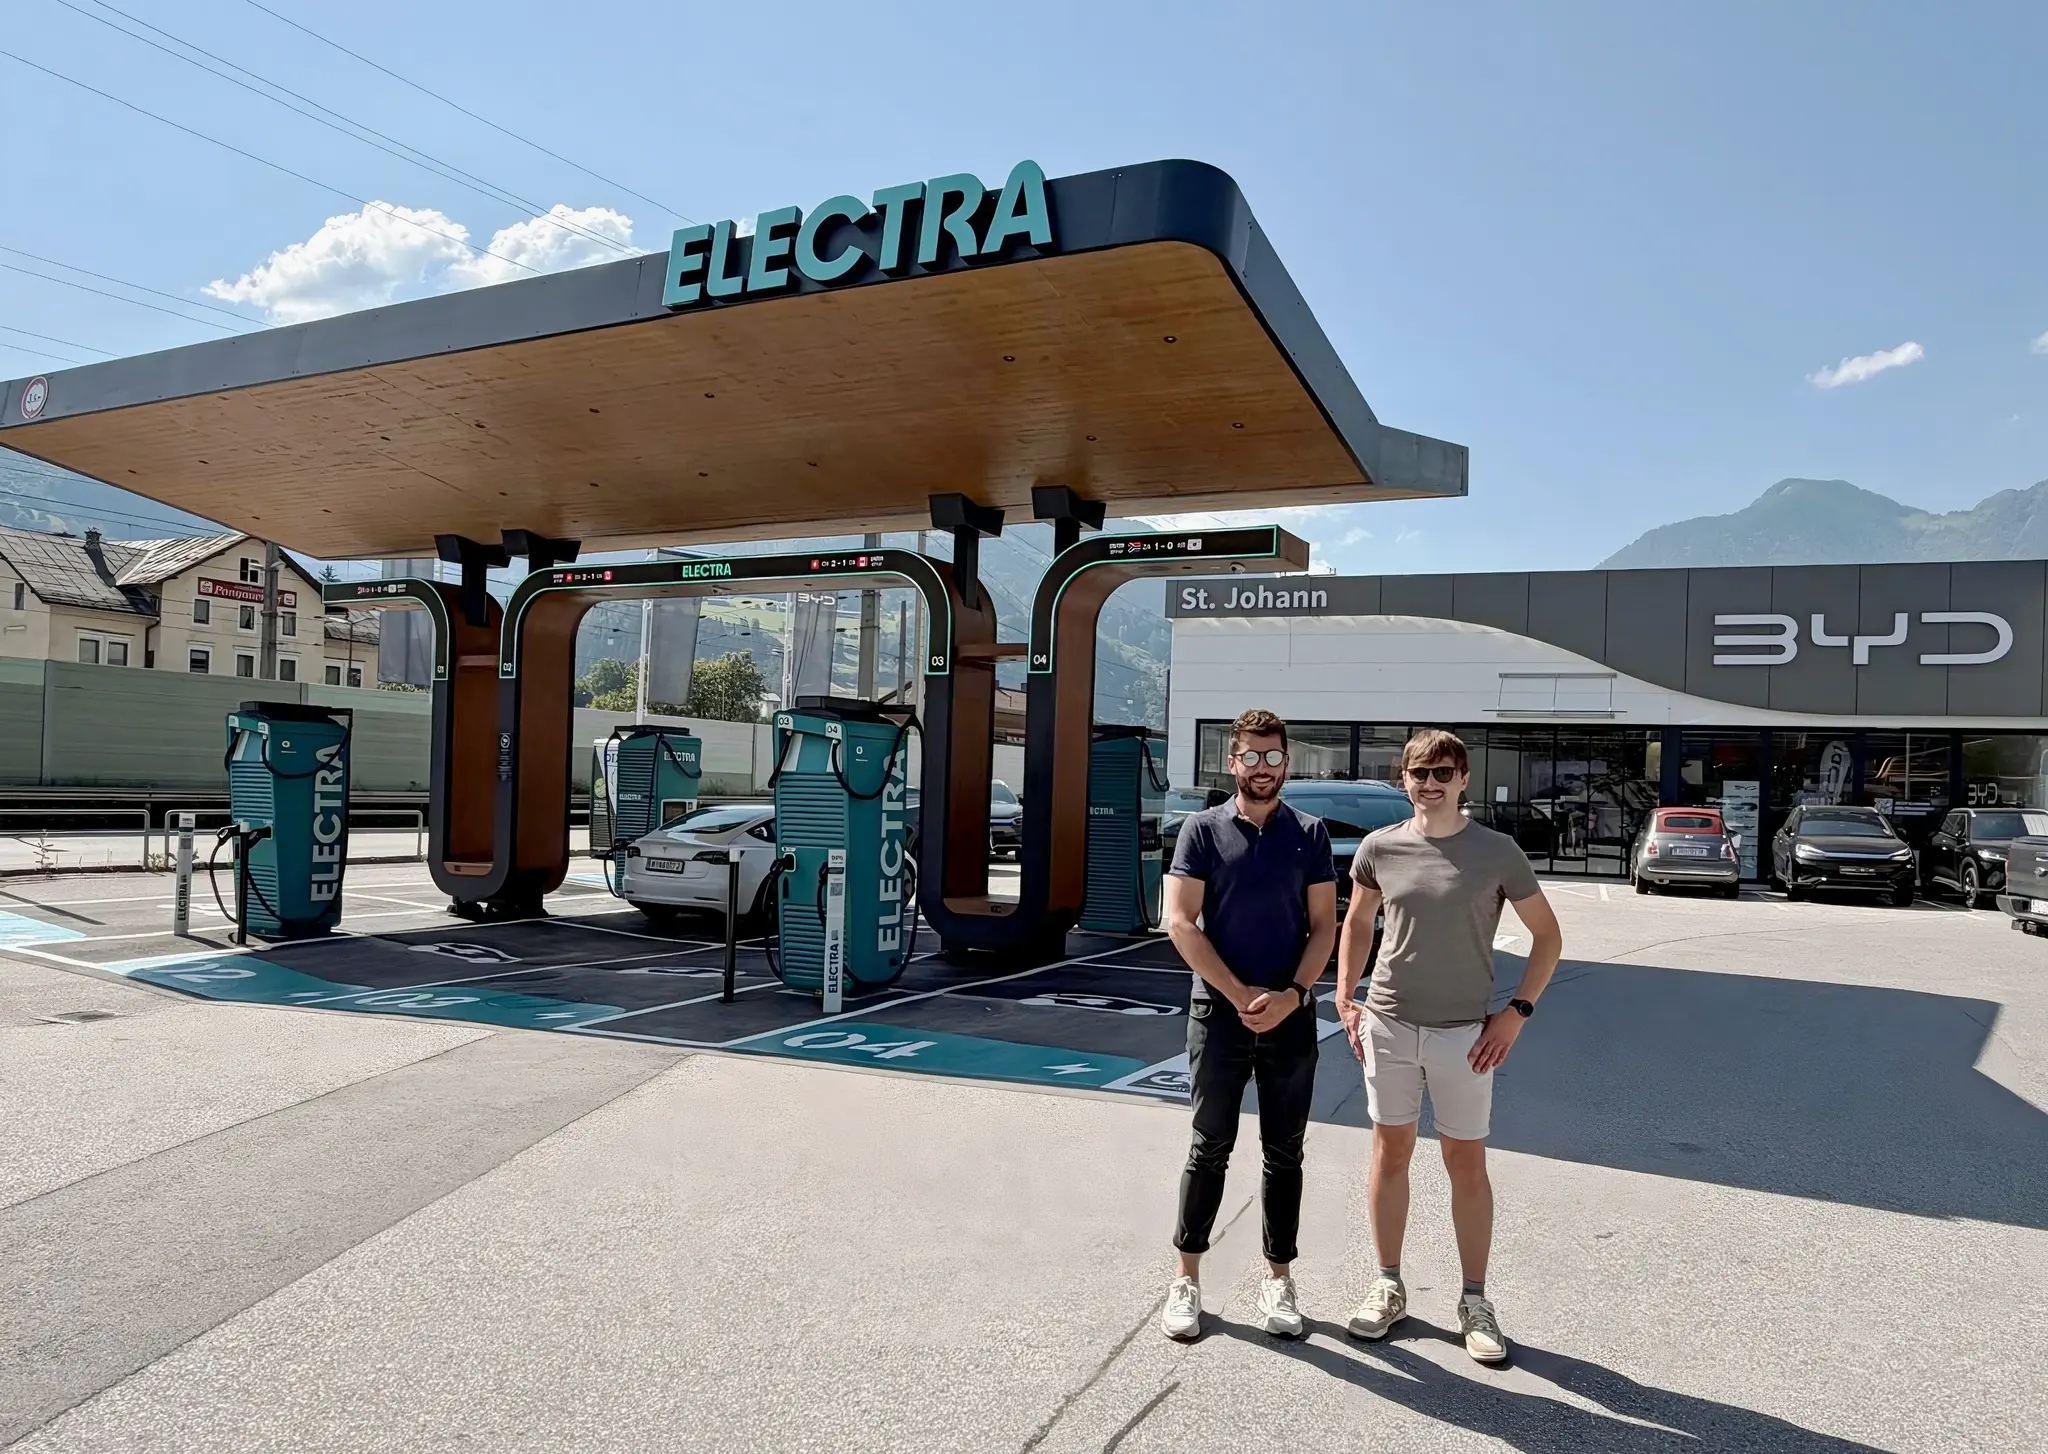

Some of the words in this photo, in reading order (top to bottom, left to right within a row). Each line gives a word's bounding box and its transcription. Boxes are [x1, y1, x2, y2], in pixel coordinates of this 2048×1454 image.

[662, 160, 1052, 307] ELECTRA
[682, 563, 732, 578] ELECTRA
[797, 592, 836, 606] BYD
[1181, 586, 1216, 610] St.
[1224, 584, 1328, 610] Johann
[1713, 611, 2014, 666] BYD
[931, 655, 945, 667] 03
[1033, 654, 1047, 665] 04
[778, 717, 790, 726] 03
[826, 725, 838, 734] 04
[310, 743, 344, 902] ELECTRA
[878, 748, 906, 952] ELECTRA
[828, 943, 840, 994] ELECTRA
[783, 1031, 938, 1060] 04
